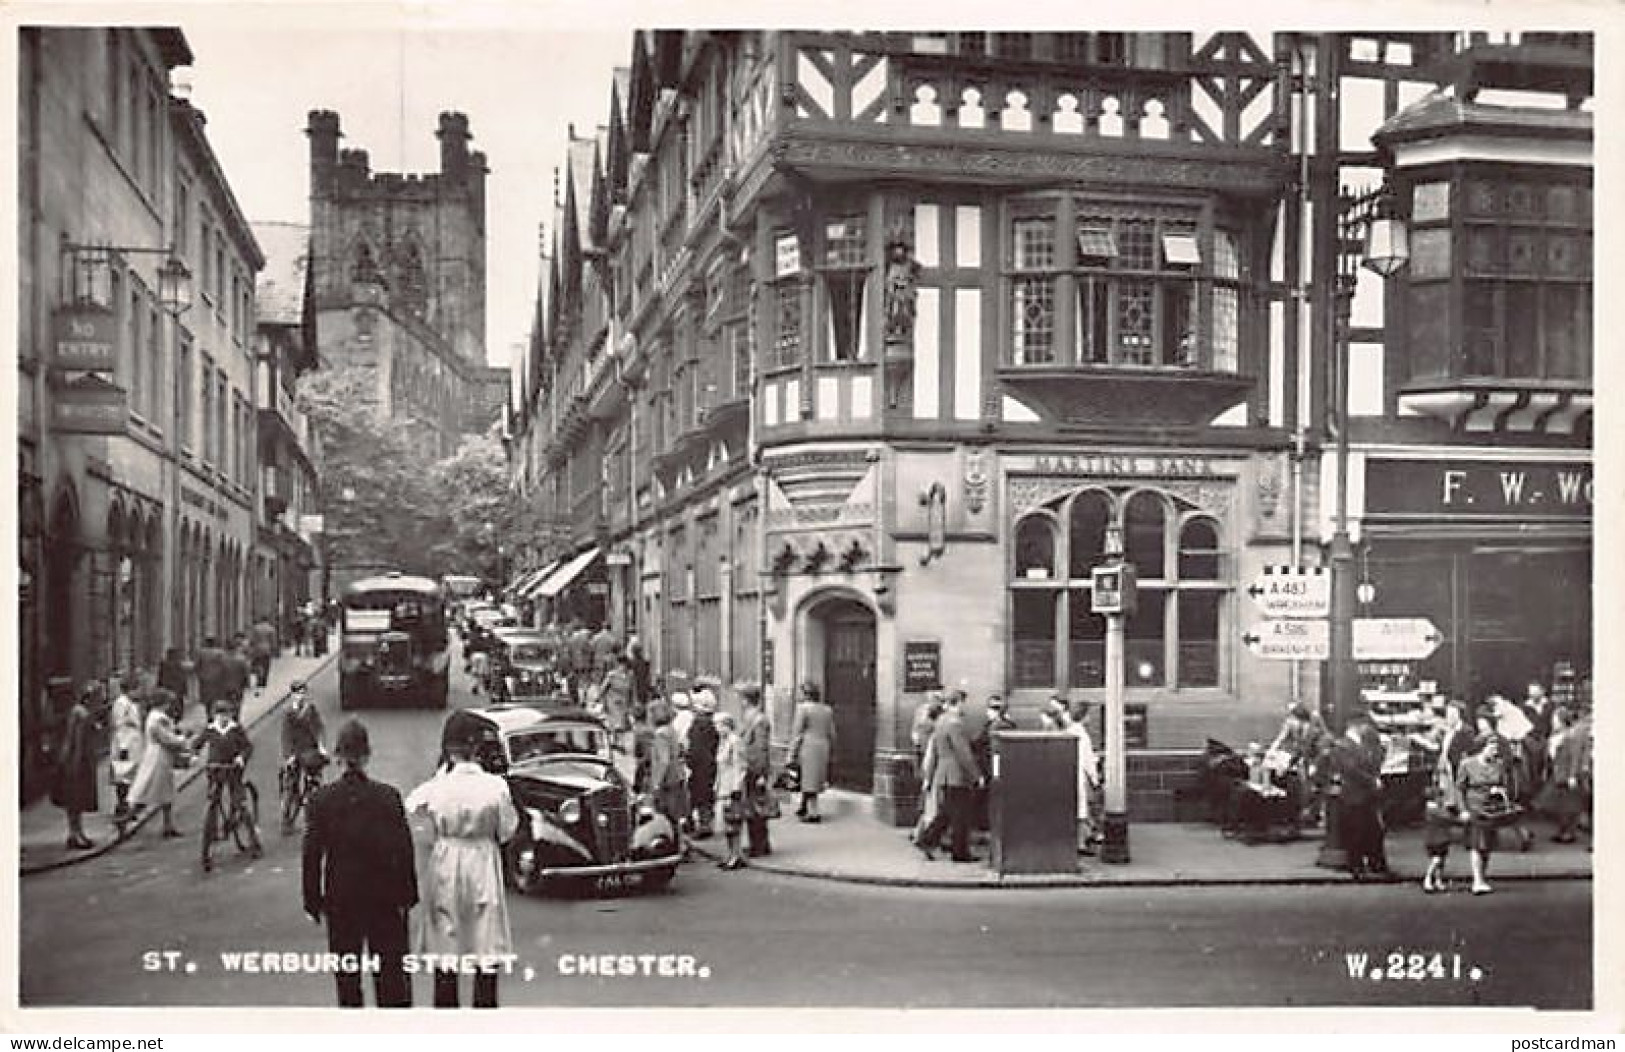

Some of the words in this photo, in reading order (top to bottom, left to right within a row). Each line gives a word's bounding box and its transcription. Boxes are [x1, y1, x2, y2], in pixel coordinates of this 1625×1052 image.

[58, 341, 114, 357] ENTRY
[1155, 456, 1213, 475] BANK
[1443, 470, 1474, 504] F.
